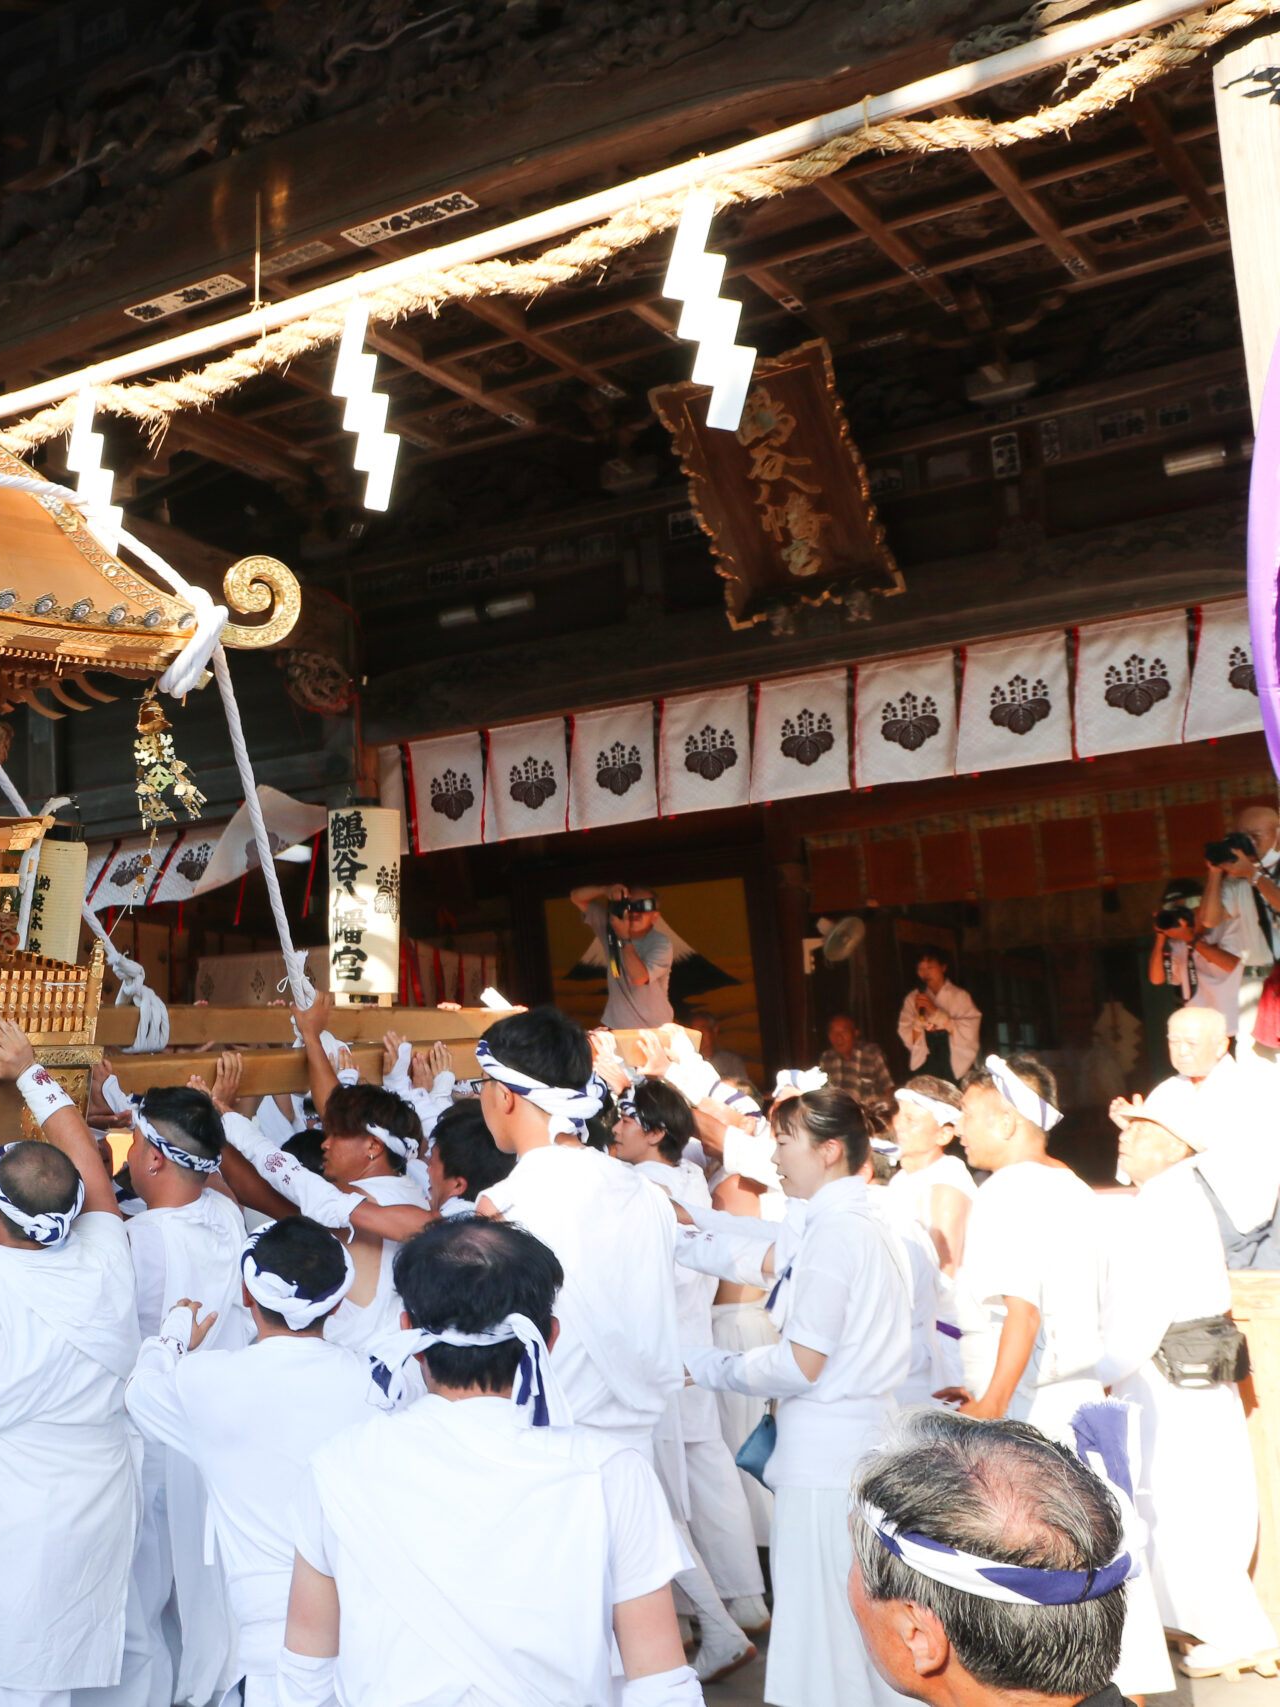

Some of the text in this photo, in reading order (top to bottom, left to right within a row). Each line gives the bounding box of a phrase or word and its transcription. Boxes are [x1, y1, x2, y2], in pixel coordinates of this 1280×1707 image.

[330, 810, 368, 982] 鶴谷八幡宮
